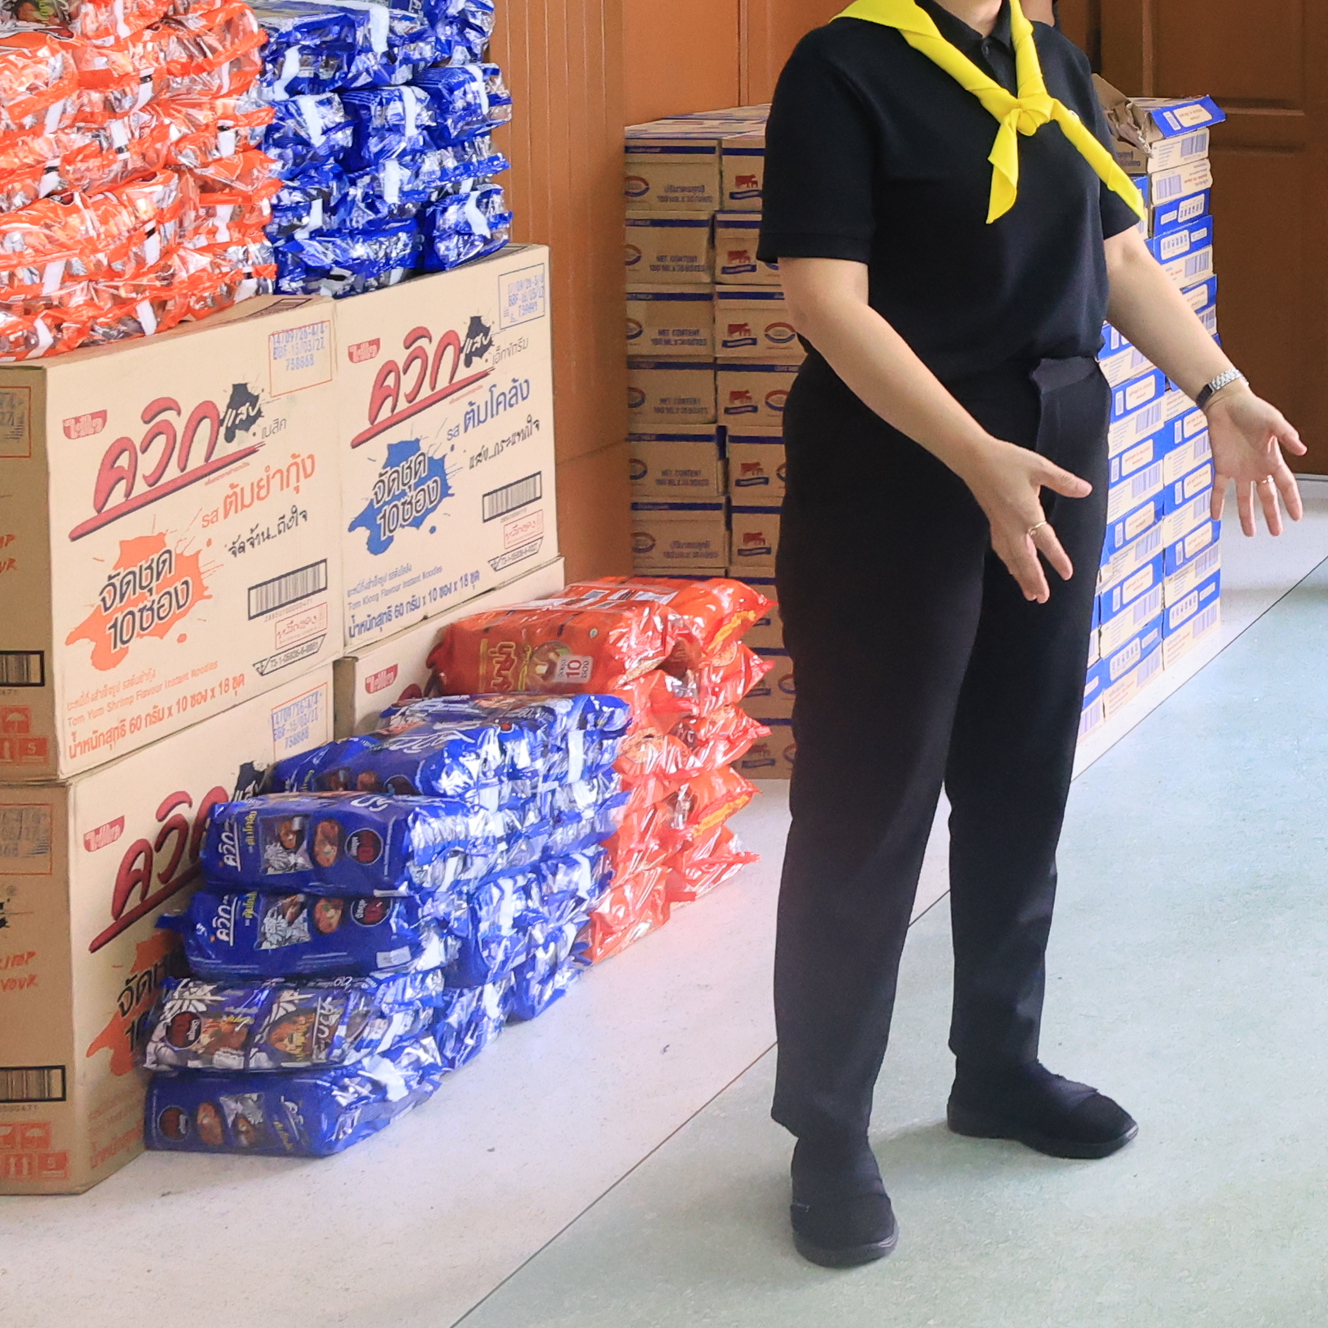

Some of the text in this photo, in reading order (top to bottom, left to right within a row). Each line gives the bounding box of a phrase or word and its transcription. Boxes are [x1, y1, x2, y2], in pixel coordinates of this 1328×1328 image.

[368, 326, 461, 426] ควิก
[93, 397, 220, 514] ควิก
[372, 452, 426, 506] จัดชุด
[202, 508, 219, 528] รส
[223, 453, 315, 520] ต้มยำกุ้ง
[379, 478, 439, 537] 10ซอง
[99, 549, 172, 612] จัดชุด
[428, 587, 438, 602] 10
[108, 580, 190, 650] 10ซอง
[567, 660, 581, 679] 10
[69, 717, 127, 759] น้ำหนักสุทธิ
[129, 714, 142, 734] 60
[144, 705, 165, 729] กรัม
[175, 696, 188, 713] 10
[218, 678, 230, 695] 18
